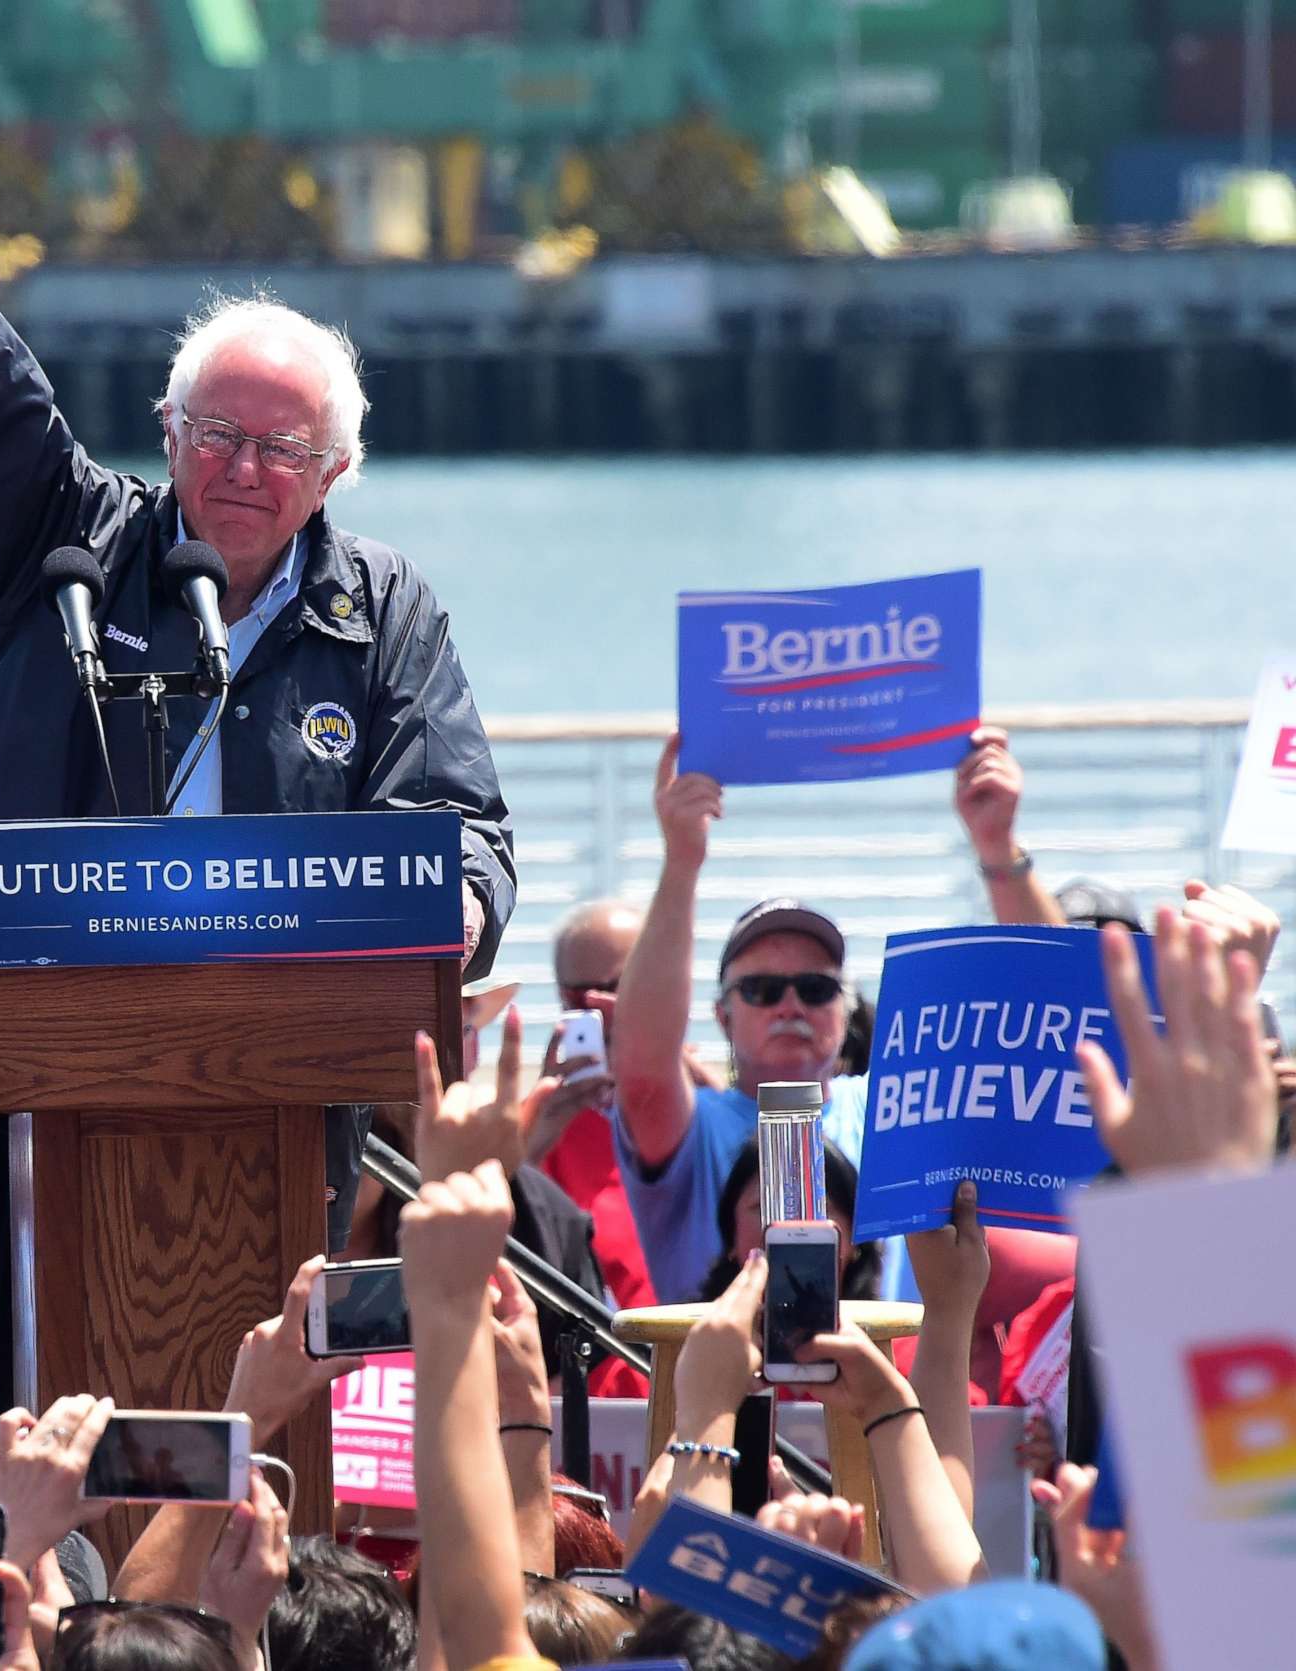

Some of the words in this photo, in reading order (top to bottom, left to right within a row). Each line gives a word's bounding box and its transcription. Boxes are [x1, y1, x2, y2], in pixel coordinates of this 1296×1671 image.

[104, 624, 148, 654] Bernie
[721, 606, 942, 677] Bernie
[757, 701, 796, 715] FOR
[802, 687, 905, 711] PRESIDENT
[309, 717, 349, 739] ILWU
[136, 860, 193, 892] TO
[204, 856, 385, 890] BELIEVE
[400, 855, 444, 886] IN
[88, 914, 300, 934] BERNIESANDERS.COM
[882, 1010, 905, 1059] A
[915, 1001, 1110, 1055] FUTURE
[874, 1065, 1094, 1132] BELIEVE
[925, 1165, 1067, 1190] BERNIESANDERS.COM
